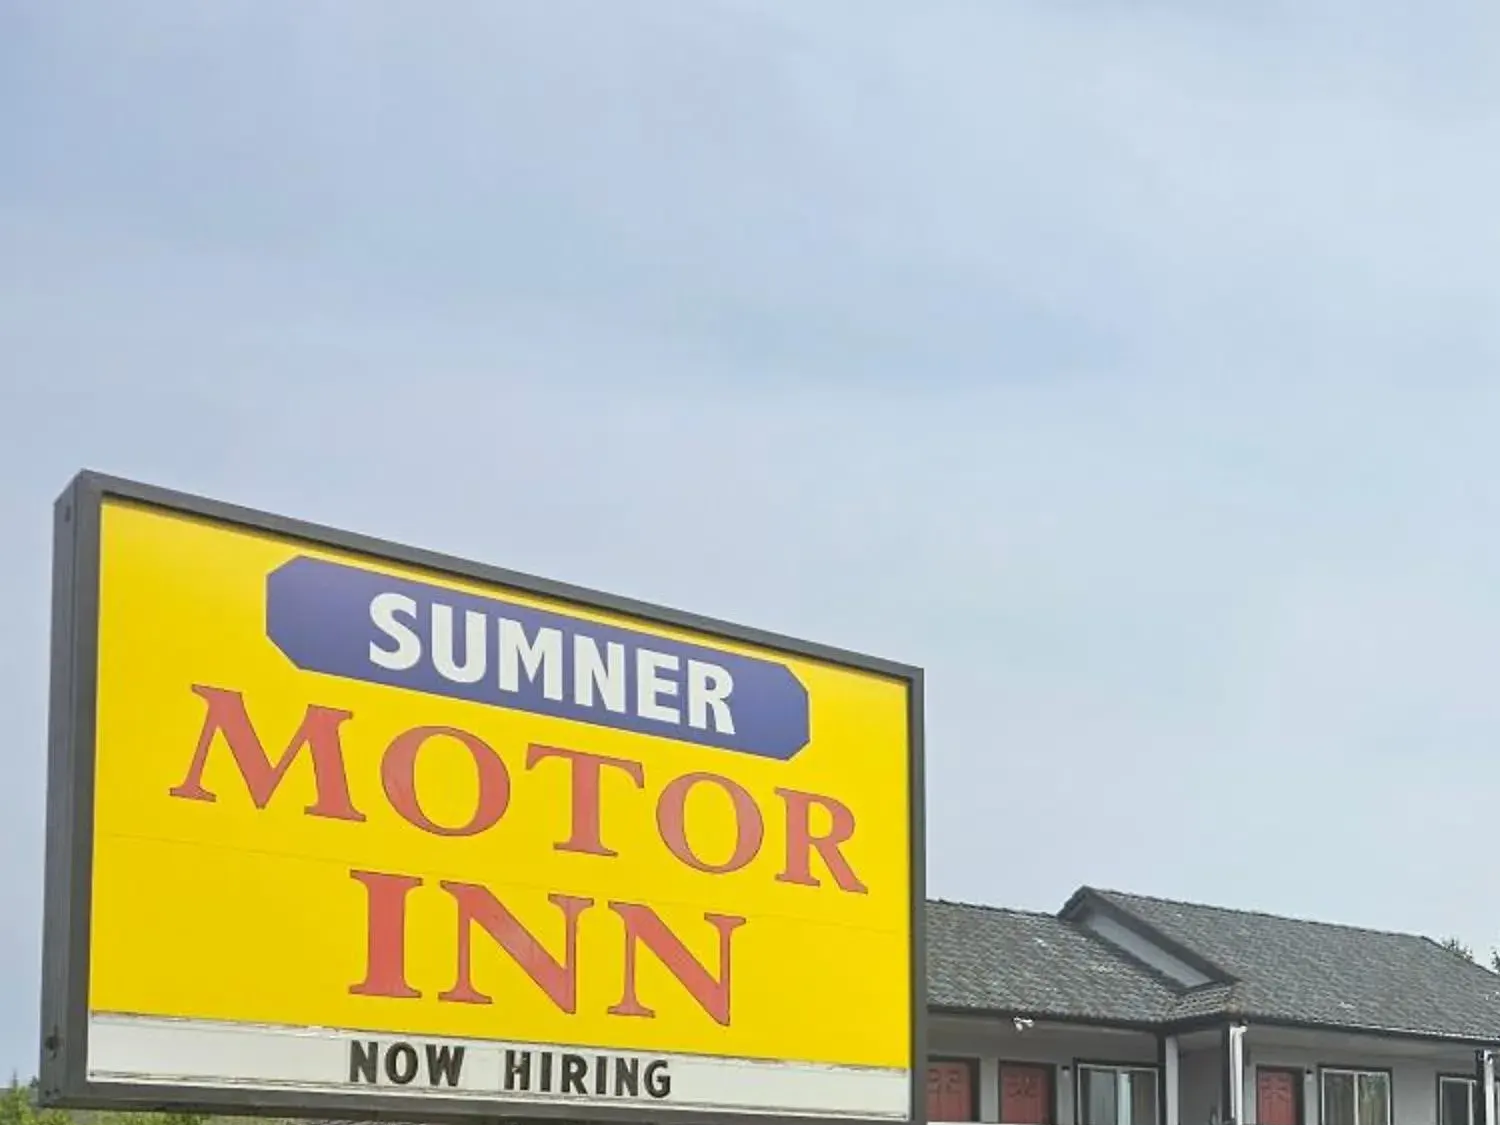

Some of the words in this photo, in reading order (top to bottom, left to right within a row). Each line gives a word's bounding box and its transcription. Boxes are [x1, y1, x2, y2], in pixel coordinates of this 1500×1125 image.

[369, 592, 736, 735] SUMNER
[169, 683, 869, 895] MOTOR
[348, 868, 747, 1027] INN
[349, 1039, 466, 1088] NOW
[504, 1049, 671, 1099] HIRING
